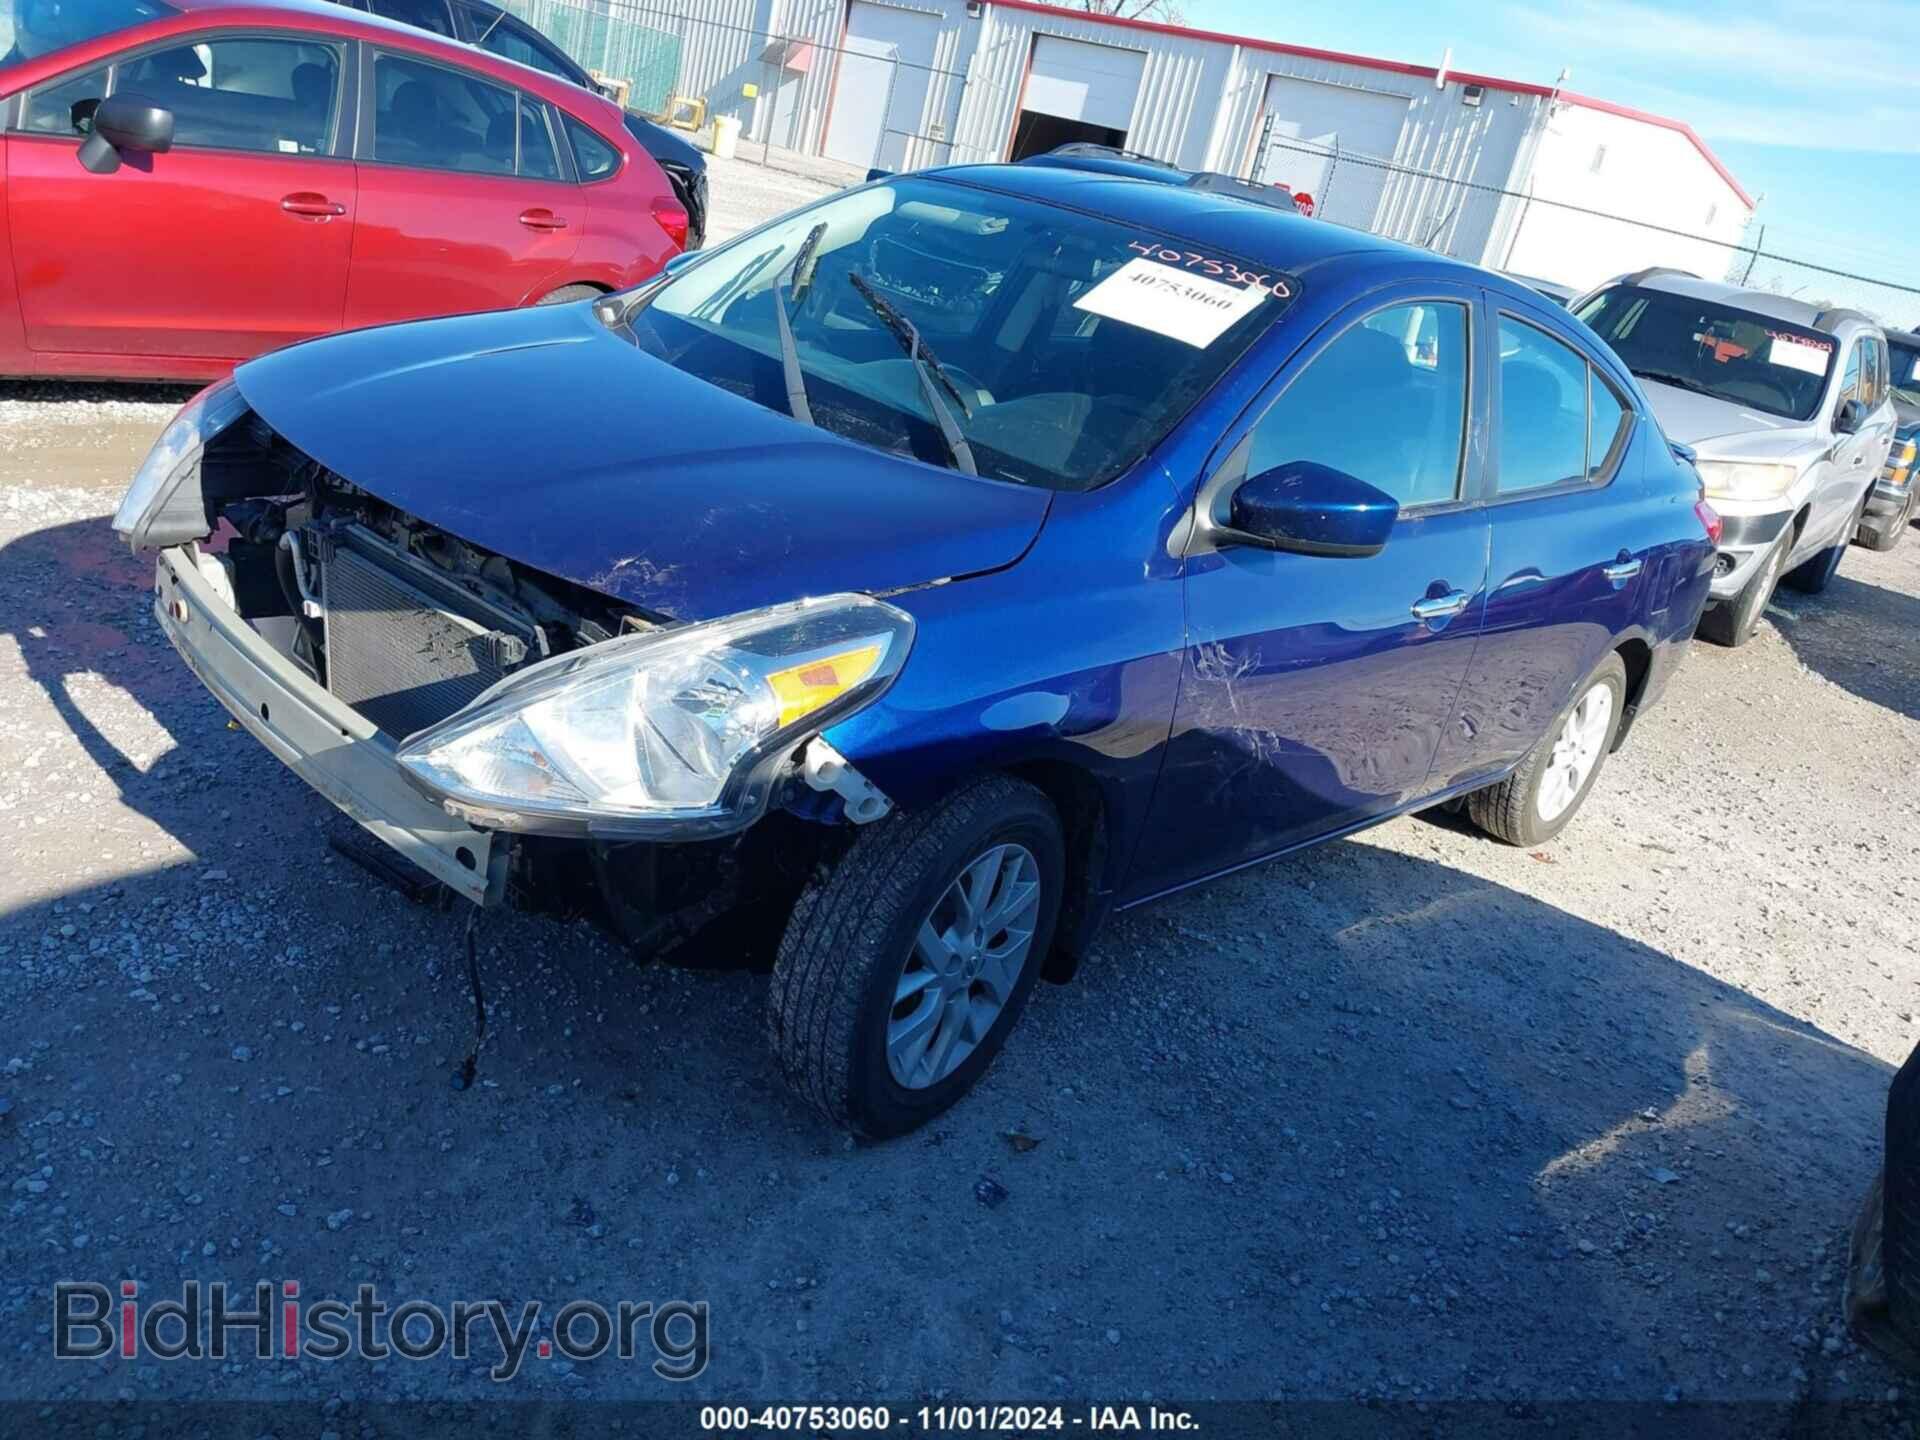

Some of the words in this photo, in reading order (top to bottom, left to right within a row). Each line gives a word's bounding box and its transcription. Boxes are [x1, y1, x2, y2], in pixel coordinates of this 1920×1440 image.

[1297, 201, 1313, 217] TOP
[1129, 240, 1290, 298] 40753060
[1128, 273, 1233, 310] 40753060
